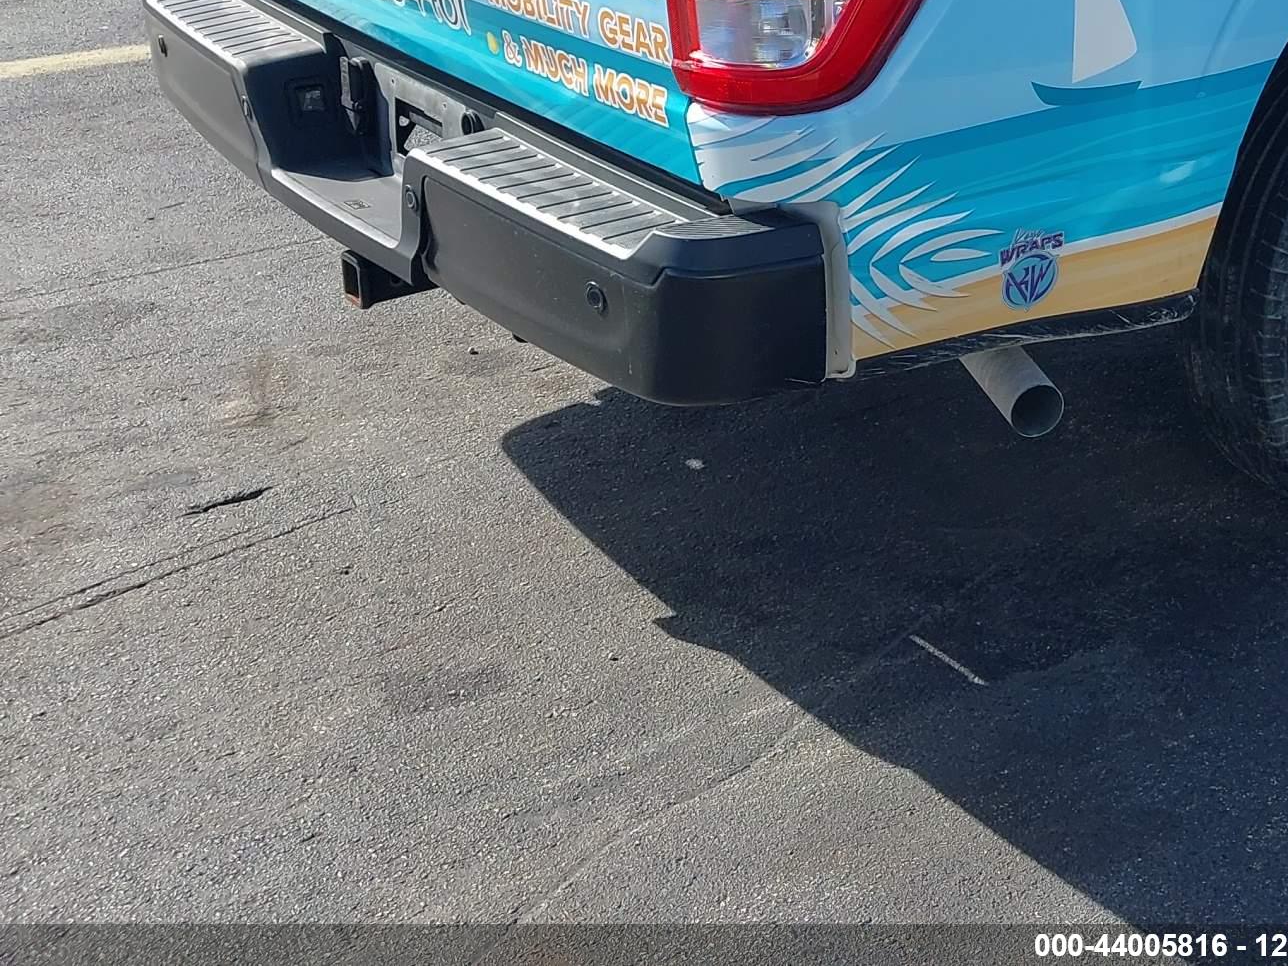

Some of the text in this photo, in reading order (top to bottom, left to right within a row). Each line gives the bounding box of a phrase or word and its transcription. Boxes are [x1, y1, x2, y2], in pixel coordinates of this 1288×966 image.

[597, 6, 674, 66] GEAR
[501, 29, 670, 128] & MUCH MORE
[999, 231, 1064, 270] WRAPS
